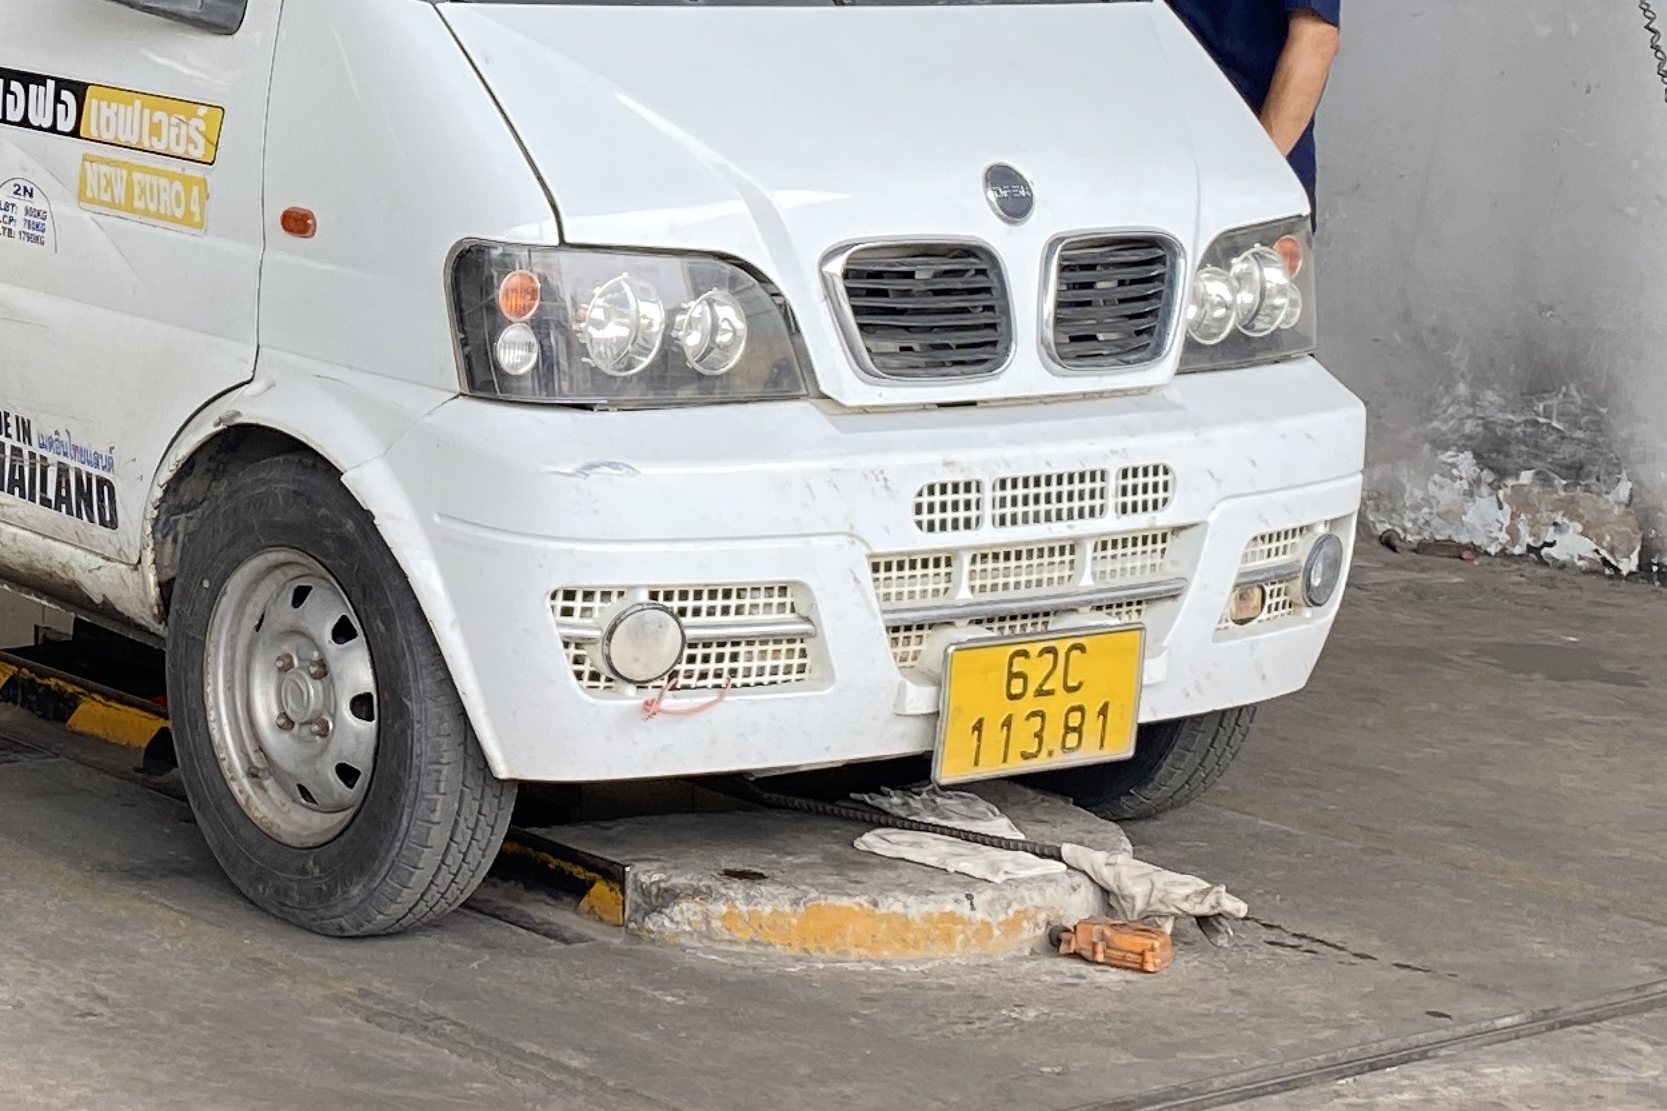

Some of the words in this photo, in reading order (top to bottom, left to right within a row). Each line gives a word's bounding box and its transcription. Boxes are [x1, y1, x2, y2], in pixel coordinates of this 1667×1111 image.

[12, 182, 35, 199] 2N
[84, 161, 128, 202] NEW
[133, 172, 185, 220] EURO
[190, 185, 201, 223] 4
[15, 415, 32, 446] IN
[1005, 642, 1087, 701] 62C
[970, 700, 1111, 768] 113.81
